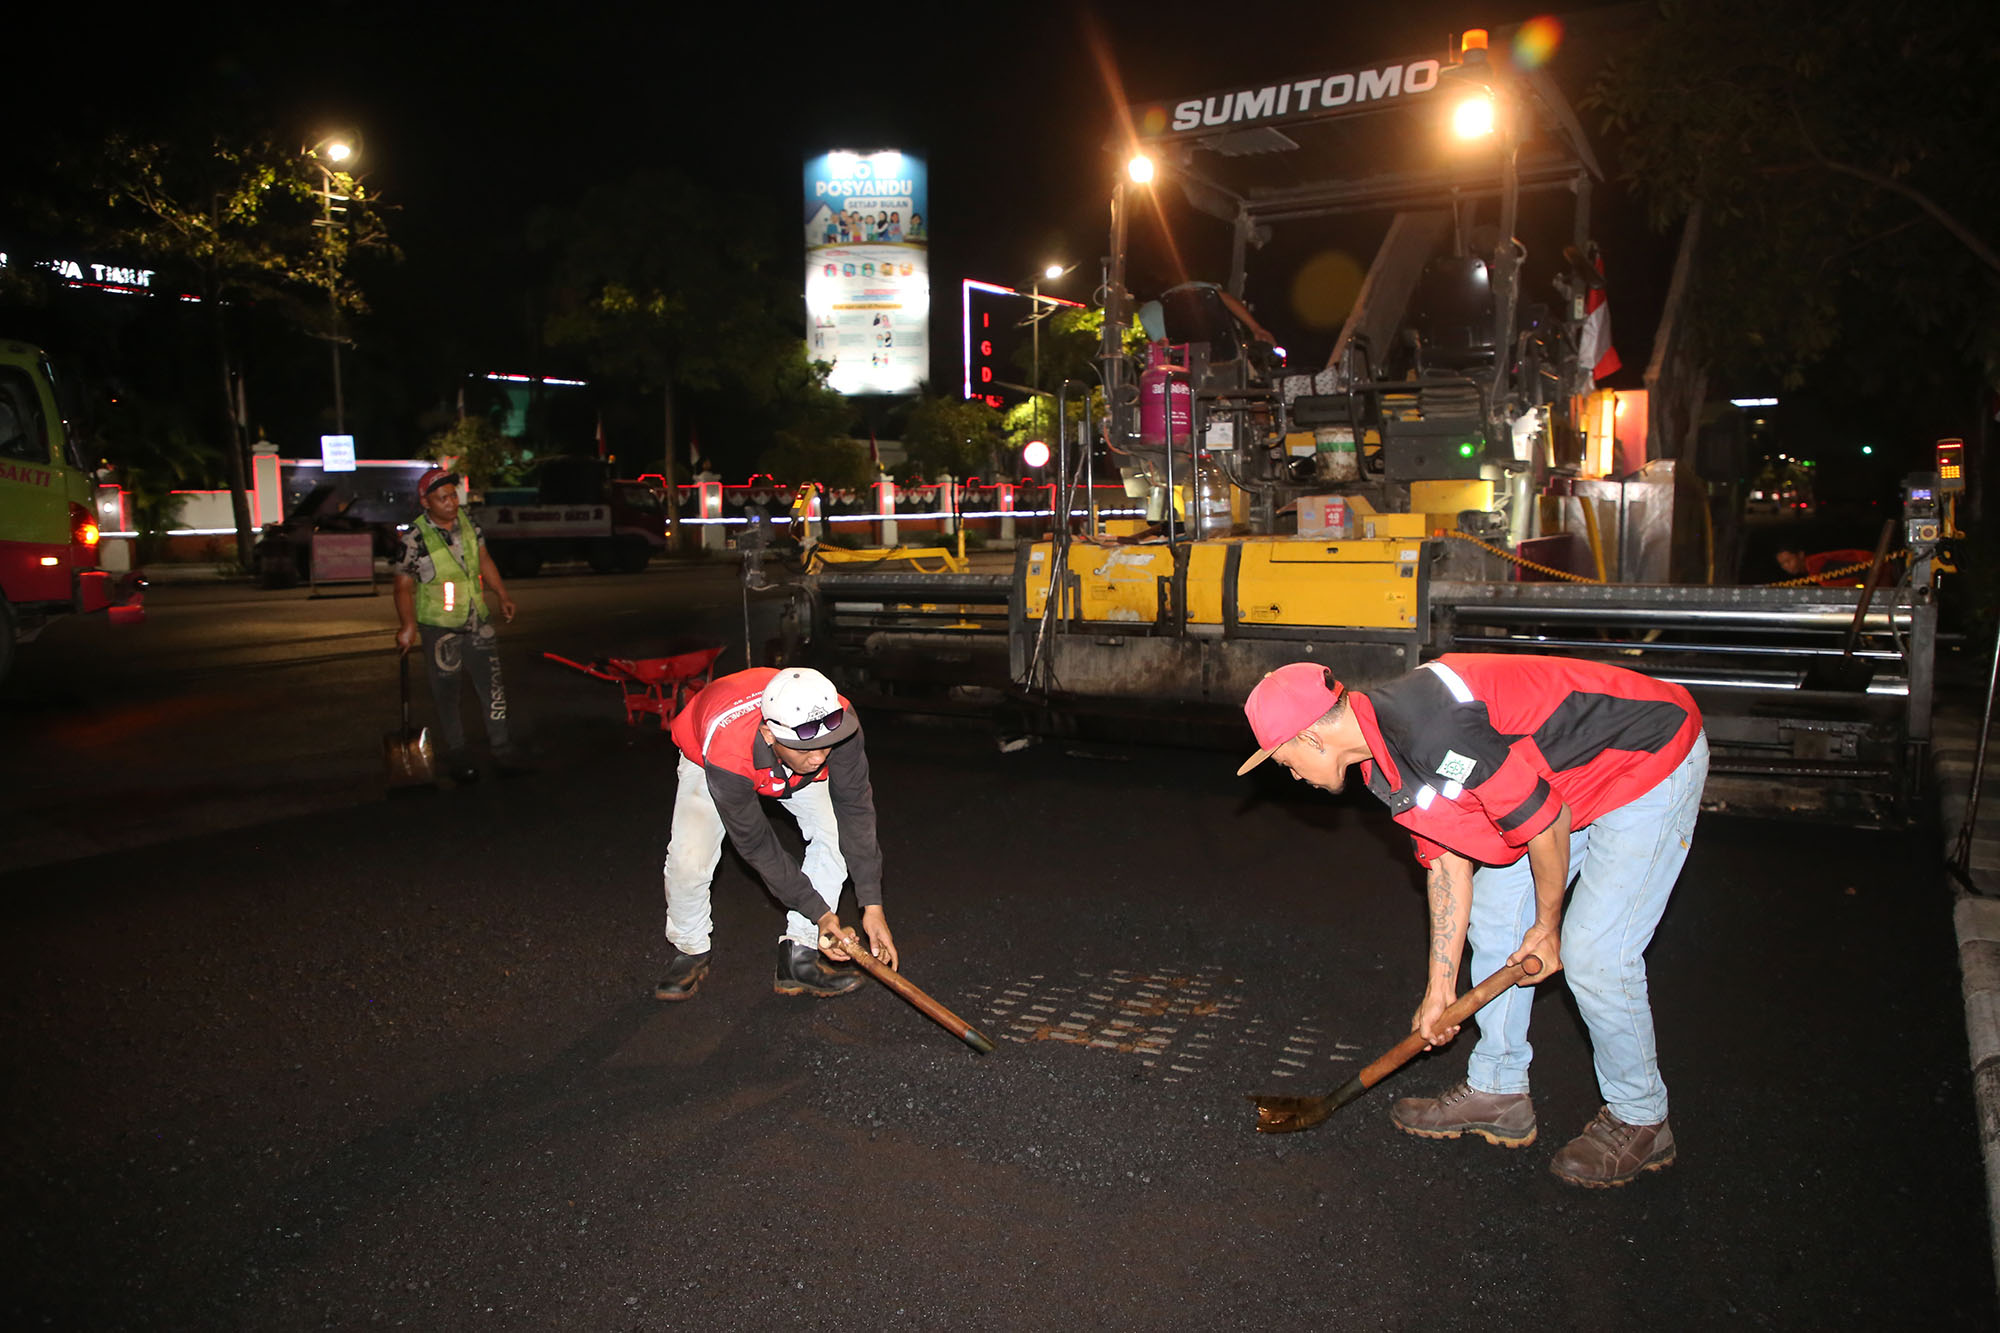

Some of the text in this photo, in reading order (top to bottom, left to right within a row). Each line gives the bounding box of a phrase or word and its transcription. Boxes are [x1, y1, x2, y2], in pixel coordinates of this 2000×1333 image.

[1172, 59, 1440, 131] SUMITOMO
[816, 179, 912, 197] POSYANDU
[848, 200, 908, 208] SETIAP BULAN
[0, 462, 51, 488] SAKTI
